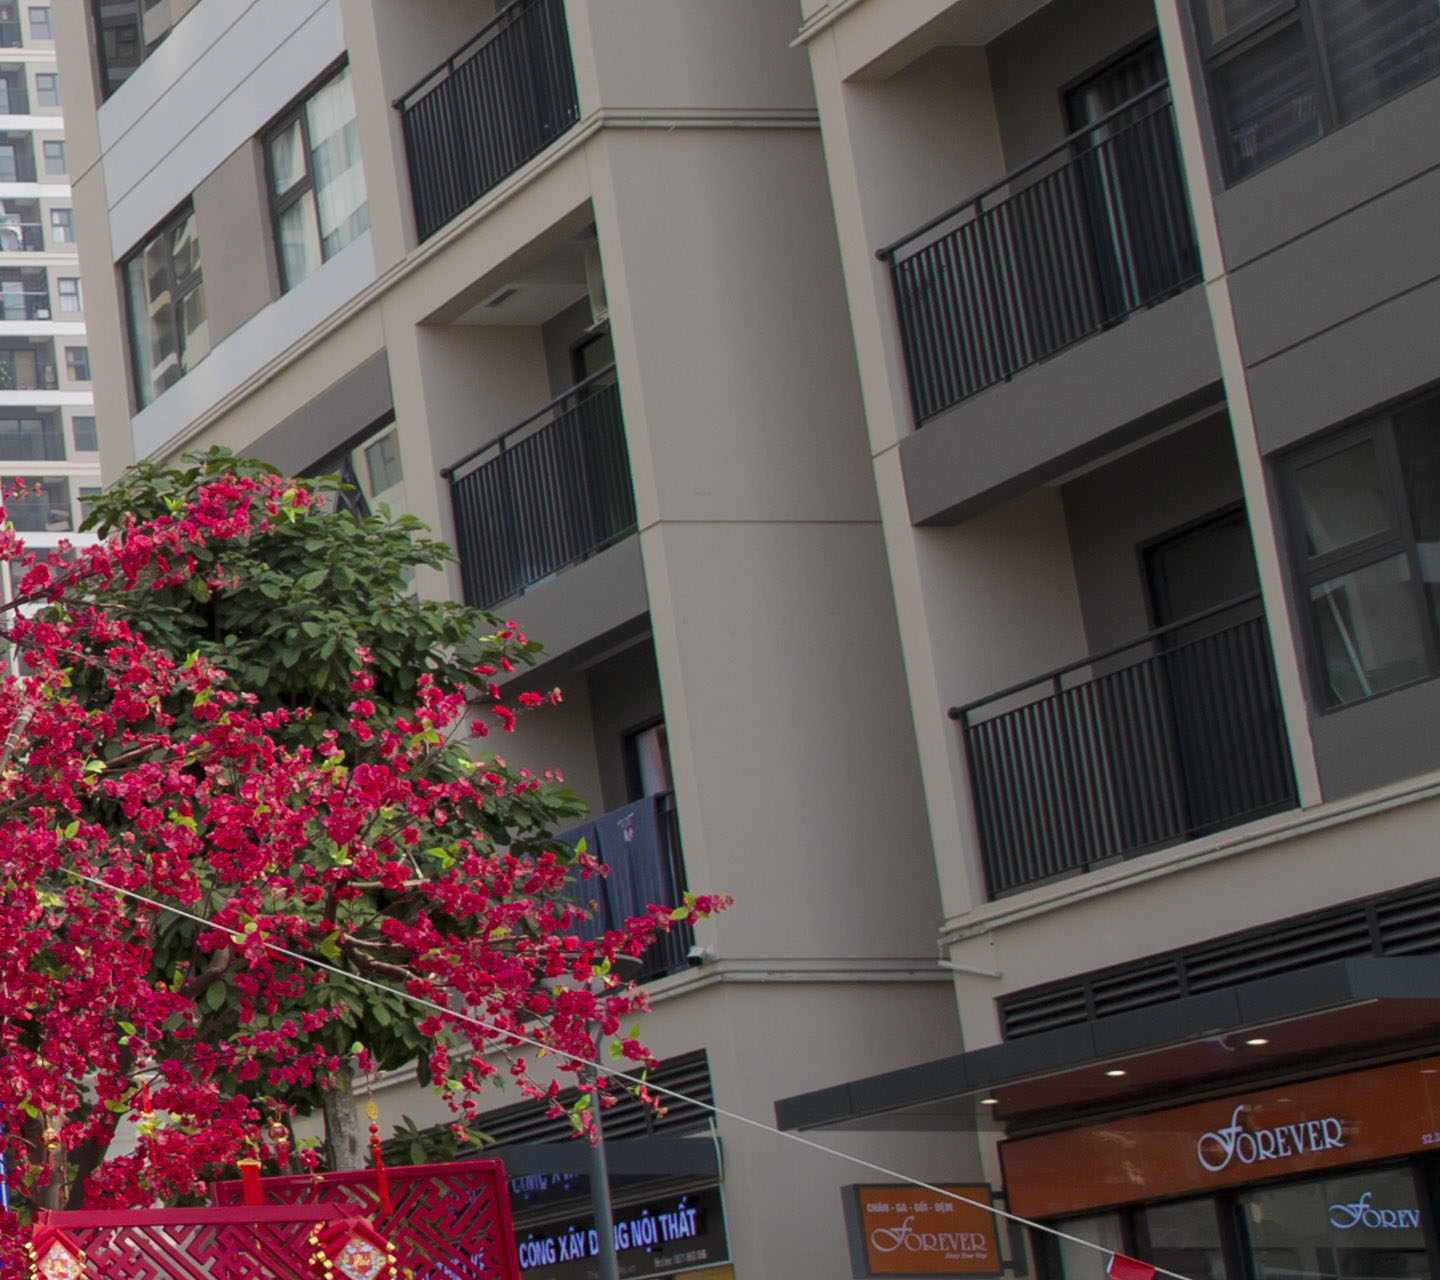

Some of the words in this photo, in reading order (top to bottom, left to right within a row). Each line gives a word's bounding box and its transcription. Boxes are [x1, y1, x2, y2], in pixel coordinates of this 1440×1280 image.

[1197, 1104, 1346, 1173] FOREVER
[518, 1232, 556, 1270] CÔNG
[558, 1225, 586, 1262] XÂY
[630, 1208, 659, 1255] NỘI
[658, 1195, 697, 1241] THẤT
